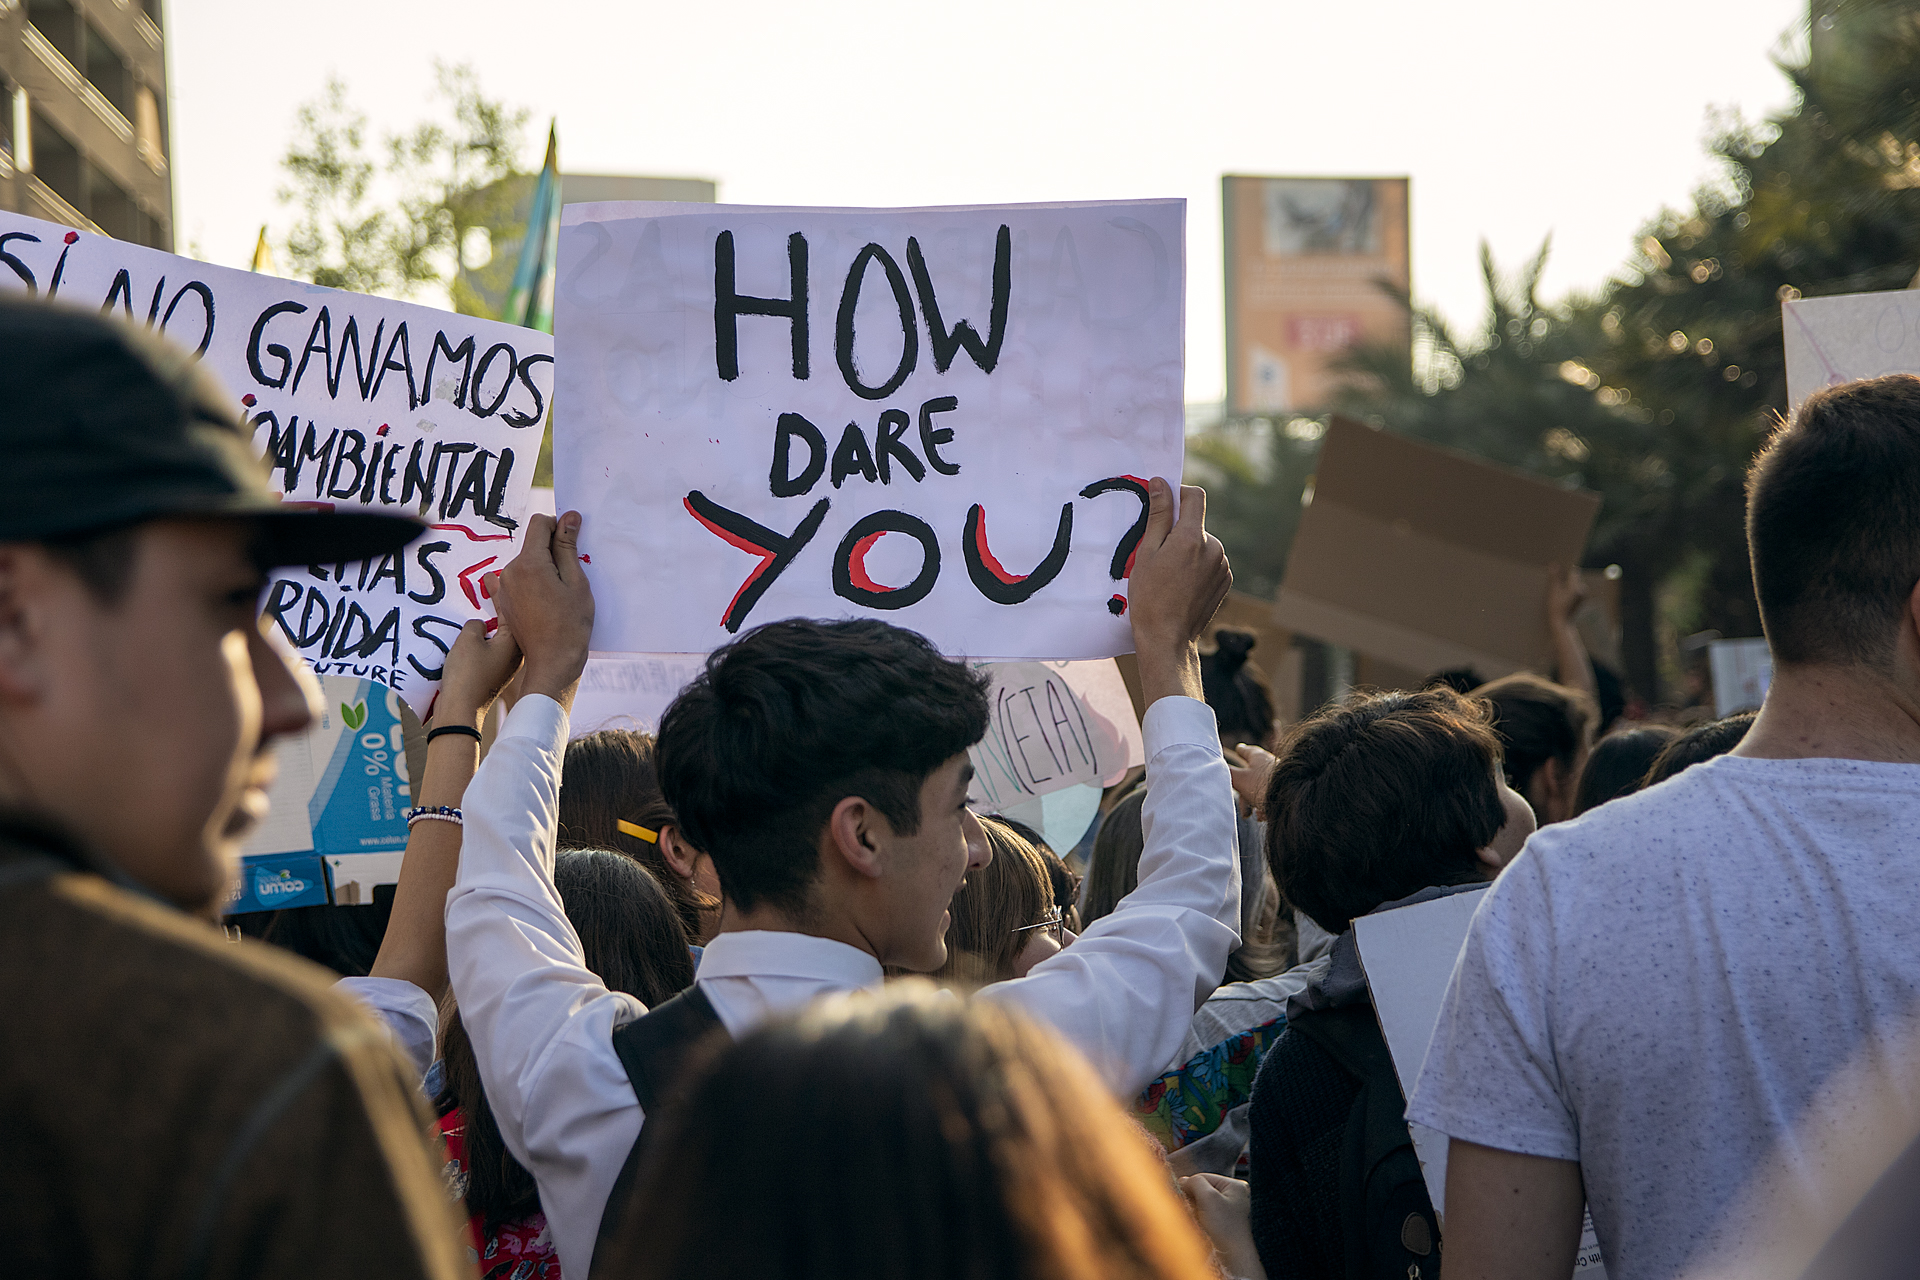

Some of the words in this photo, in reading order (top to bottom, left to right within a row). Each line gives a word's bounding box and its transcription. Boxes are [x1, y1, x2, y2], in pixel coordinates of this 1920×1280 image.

[715, 224, 1012, 400] HOW
[247, 300, 553, 428] GANAMOS
[769, 396, 960, 498] DARE
[683, 474, 1150, 634] YOU?
[262, 578, 464, 681] RDIDAS
[361, 733, 391, 776] 0%
[381, 776, 396, 821] Materia
[367, 785, 382, 821] Grasa
